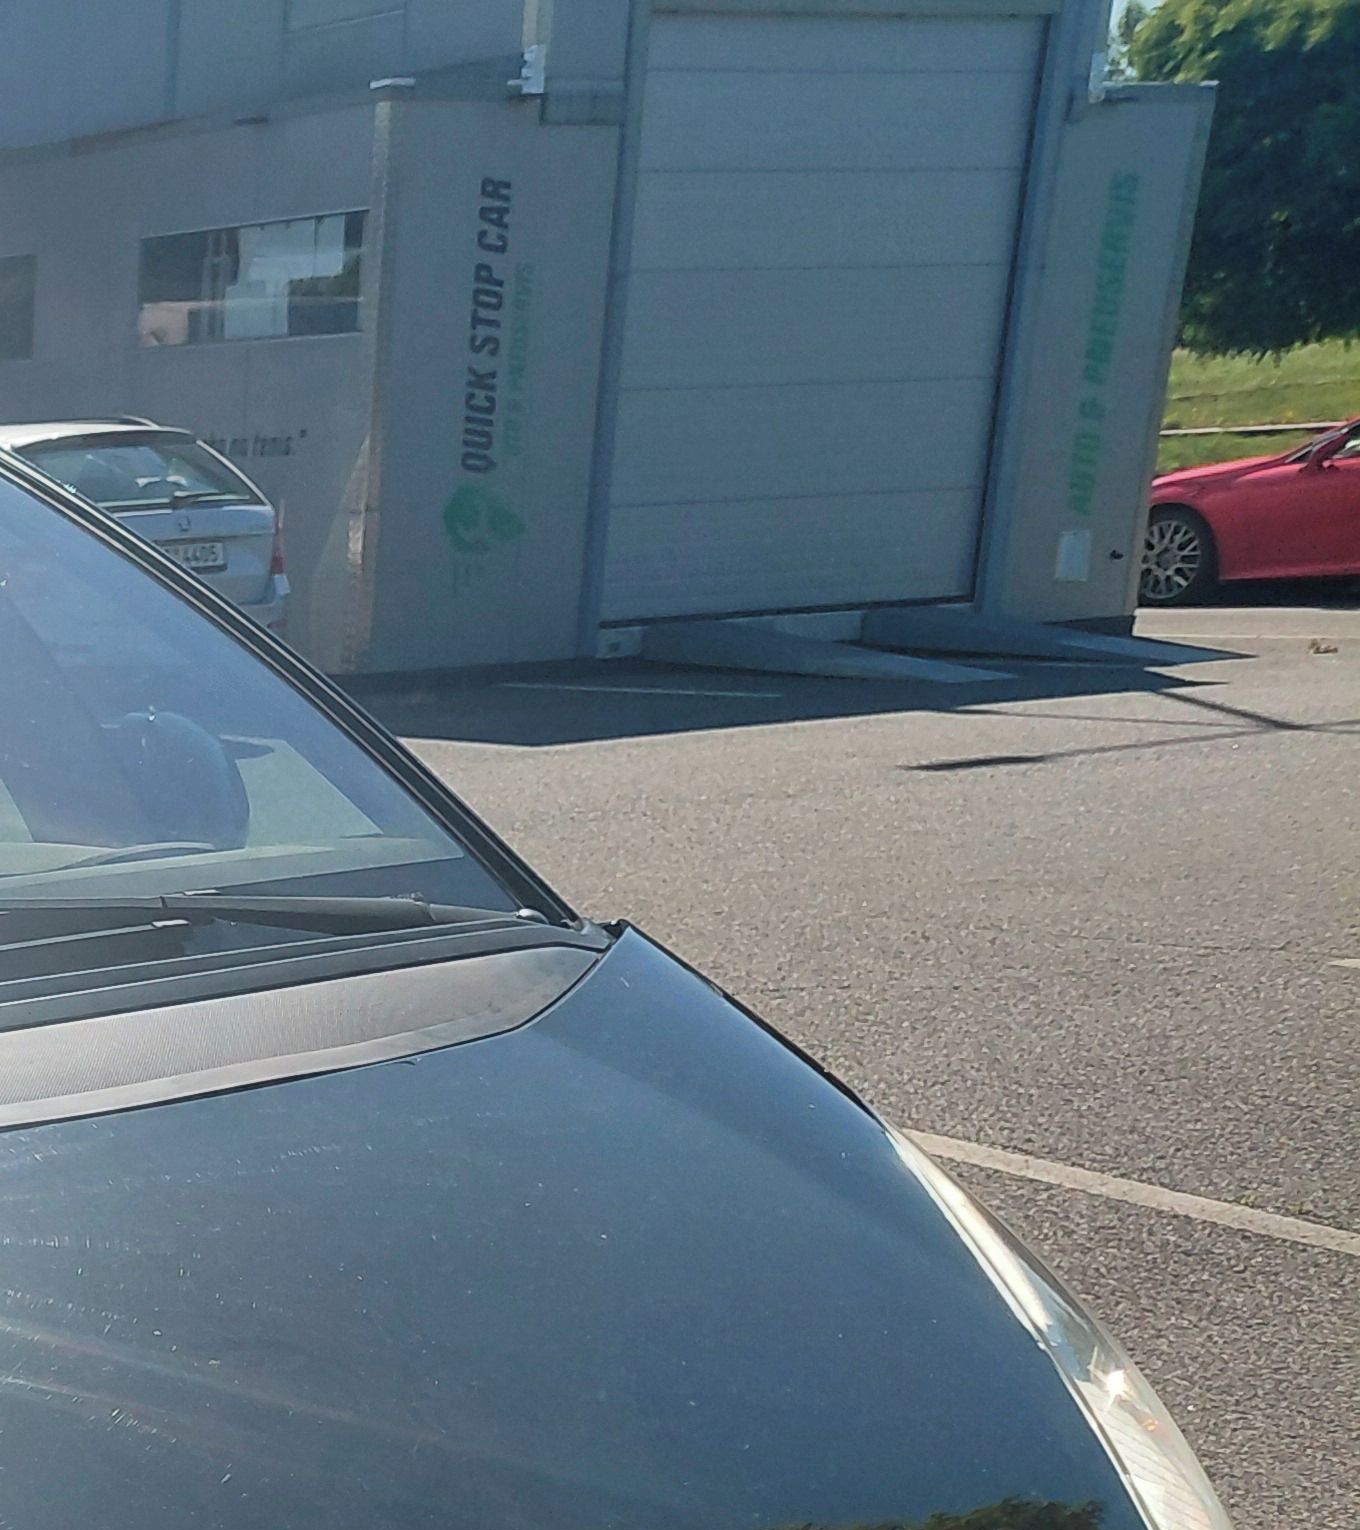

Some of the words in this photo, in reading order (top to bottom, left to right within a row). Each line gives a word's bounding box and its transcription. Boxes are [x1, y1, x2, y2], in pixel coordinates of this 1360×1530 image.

[477, 177, 513, 254] CAR
[469, 262, 505, 357] STOP
[460, 365, 498, 475] QUICK
